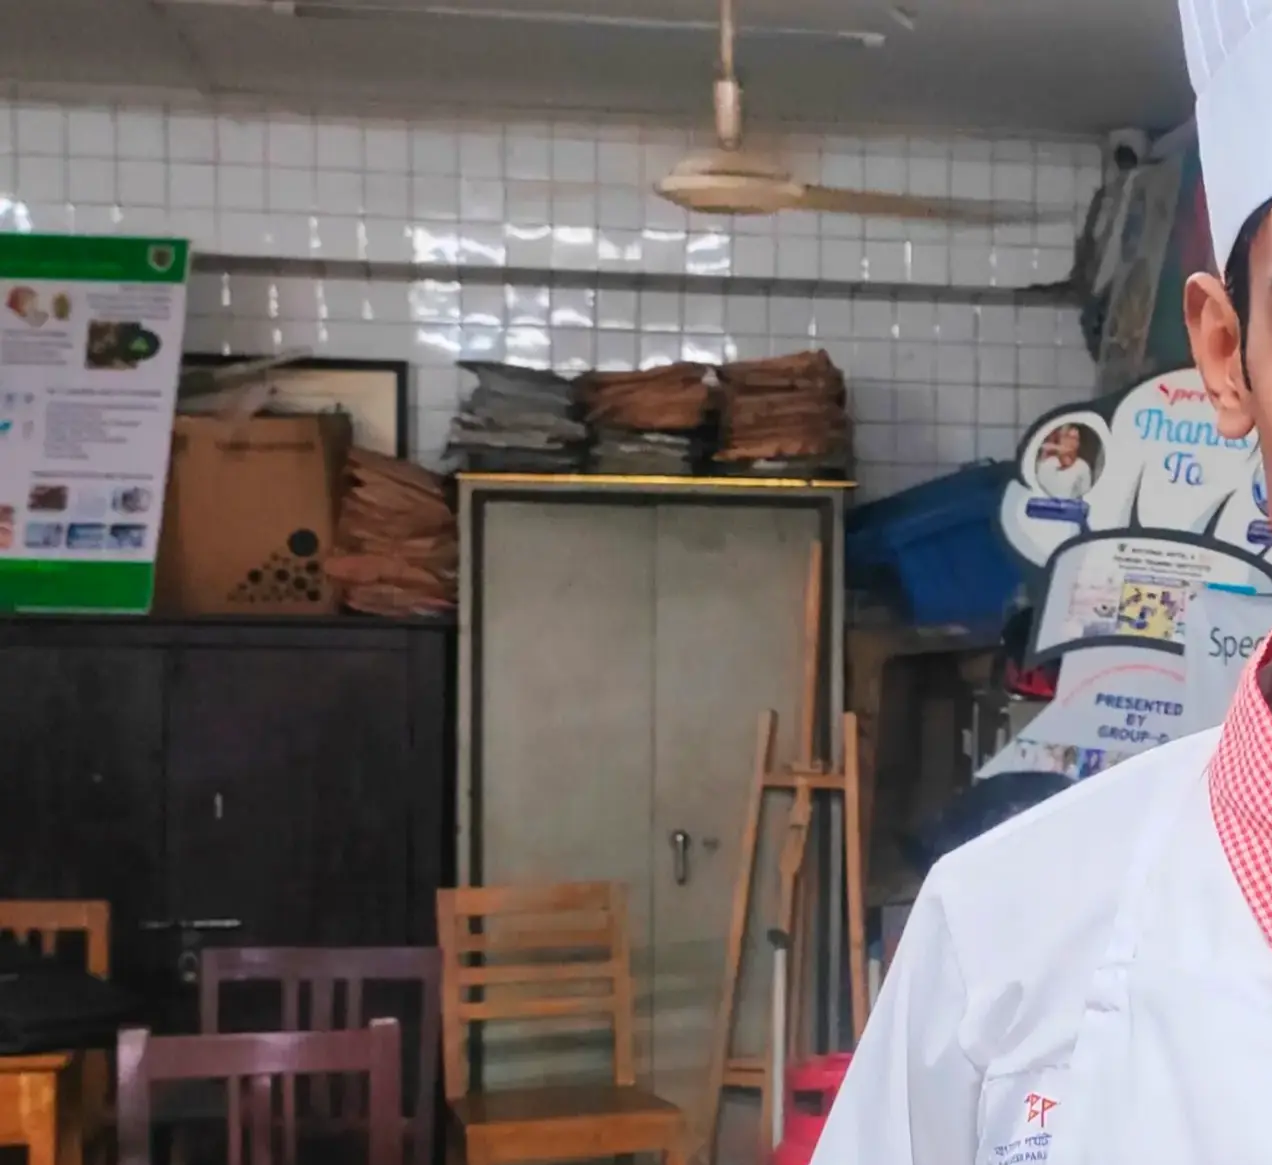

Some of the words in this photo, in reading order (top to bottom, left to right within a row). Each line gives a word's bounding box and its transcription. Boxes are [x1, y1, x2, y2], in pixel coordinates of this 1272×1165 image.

[1164, 451, 1203, 486] To
[1095, 692, 1184, 717] PRESENTED
[1125, 713, 1148, 728] BY
